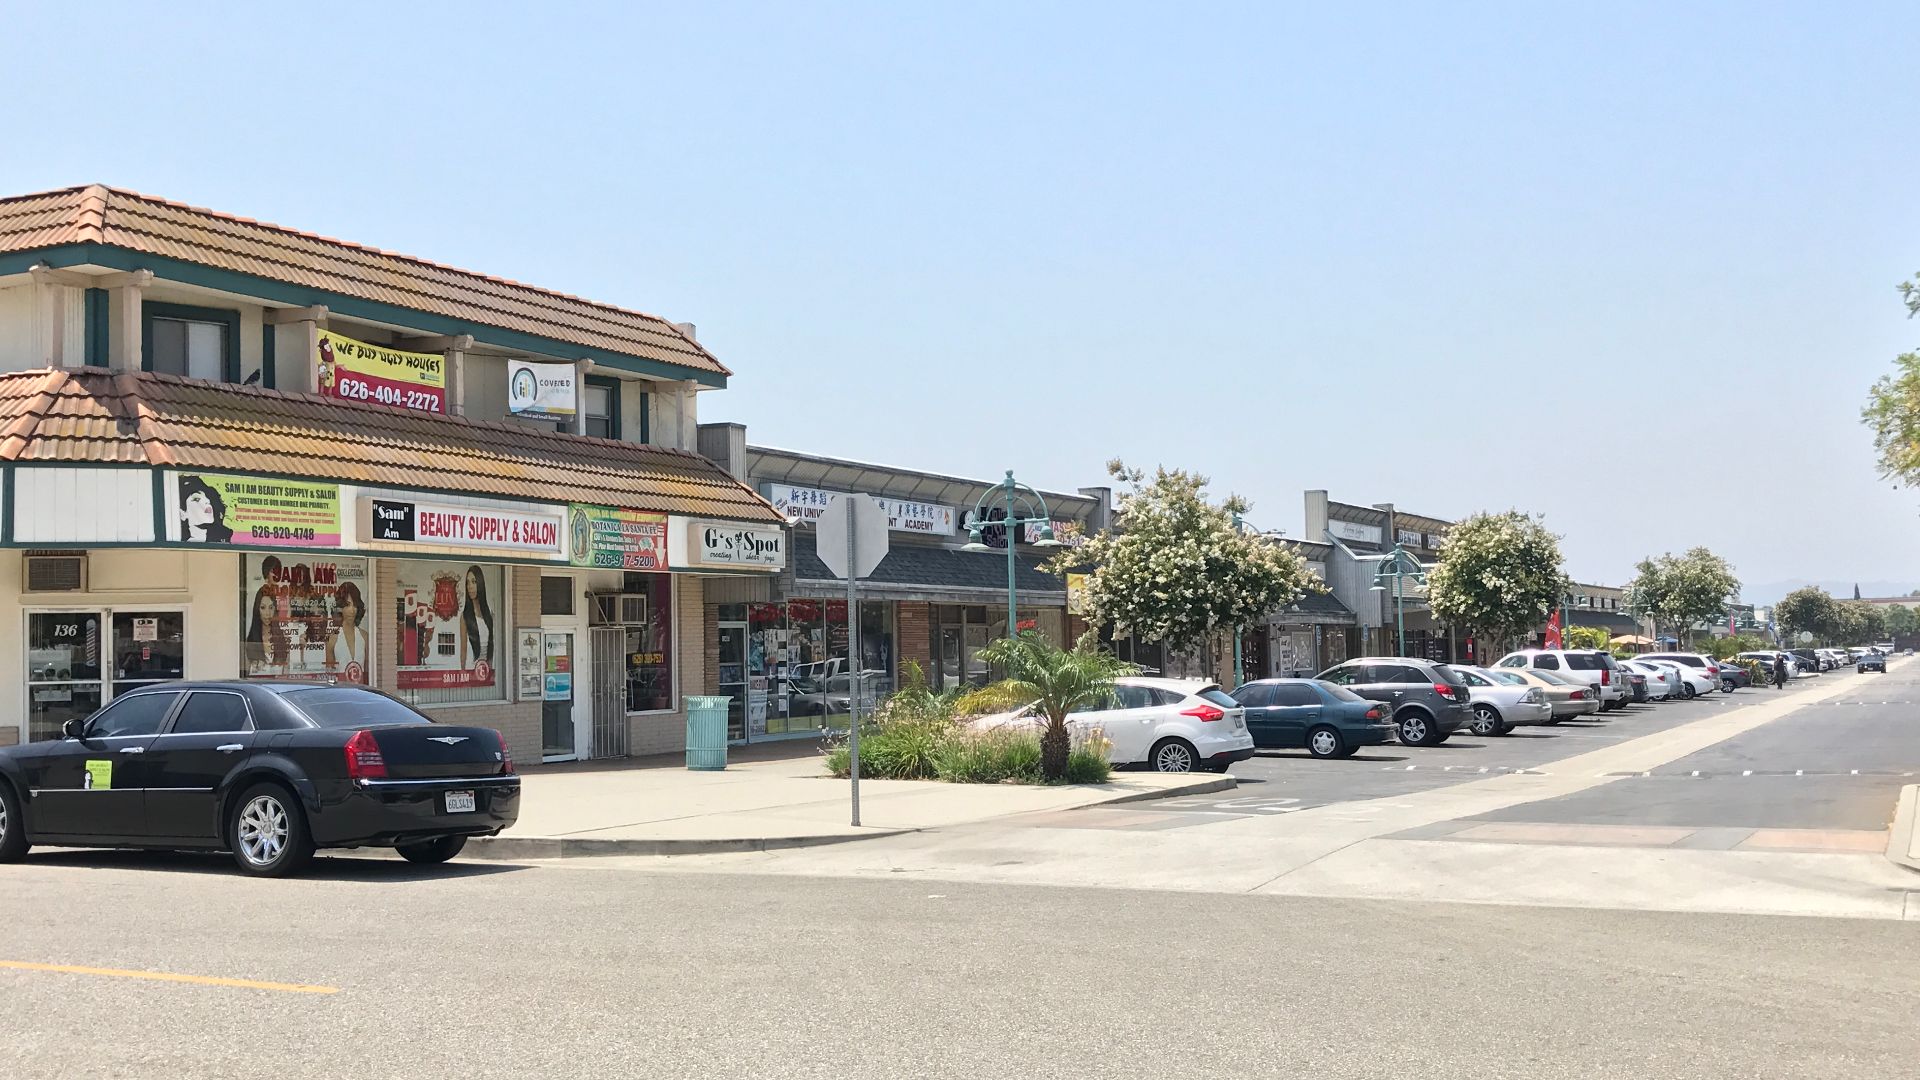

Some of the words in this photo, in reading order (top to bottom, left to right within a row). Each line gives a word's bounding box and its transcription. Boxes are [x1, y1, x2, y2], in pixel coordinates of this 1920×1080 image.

[336, 341, 354, 355] WE
[357, 347, 377, 361] BUY
[381, 350, 403, 367] UGLY
[406, 356, 441, 374] HOUSES
[539, 379, 571, 388] COVERED
[339, 378, 440, 412] 626-404-2272
[225, 482, 241, 494] SAM
[246, 484, 257, 495] AM
[258, 485, 283, 497] BEAUTY
[285, 487, 309, 499] SUPPLY
[310, 490, 315, 499] &
[316, 490, 337, 501] SALON
[787, 505, 803, 518] NEW
[905, 519, 934, 531] ACADEMY
[251, 525, 315, 541] 626-820-4748
[384, 528, 400, 539] Am
[420, 512, 466, 538] BEAUTY
[469, 516, 510, 542] SUPPLY
[513, 522, 520, 543] &
[523, 521, 557, 546] SALON
[592, 520, 621, 533] BOTANICA
[622, 523, 630, 533] LA
[630, 523, 649, 535] SANTA
[650, 525, 658, 535] FE
[743, 531, 780, 556] Spot
[594, 551, 655, 568] 626-917-5200
[54, 624, 78, 637] 136
